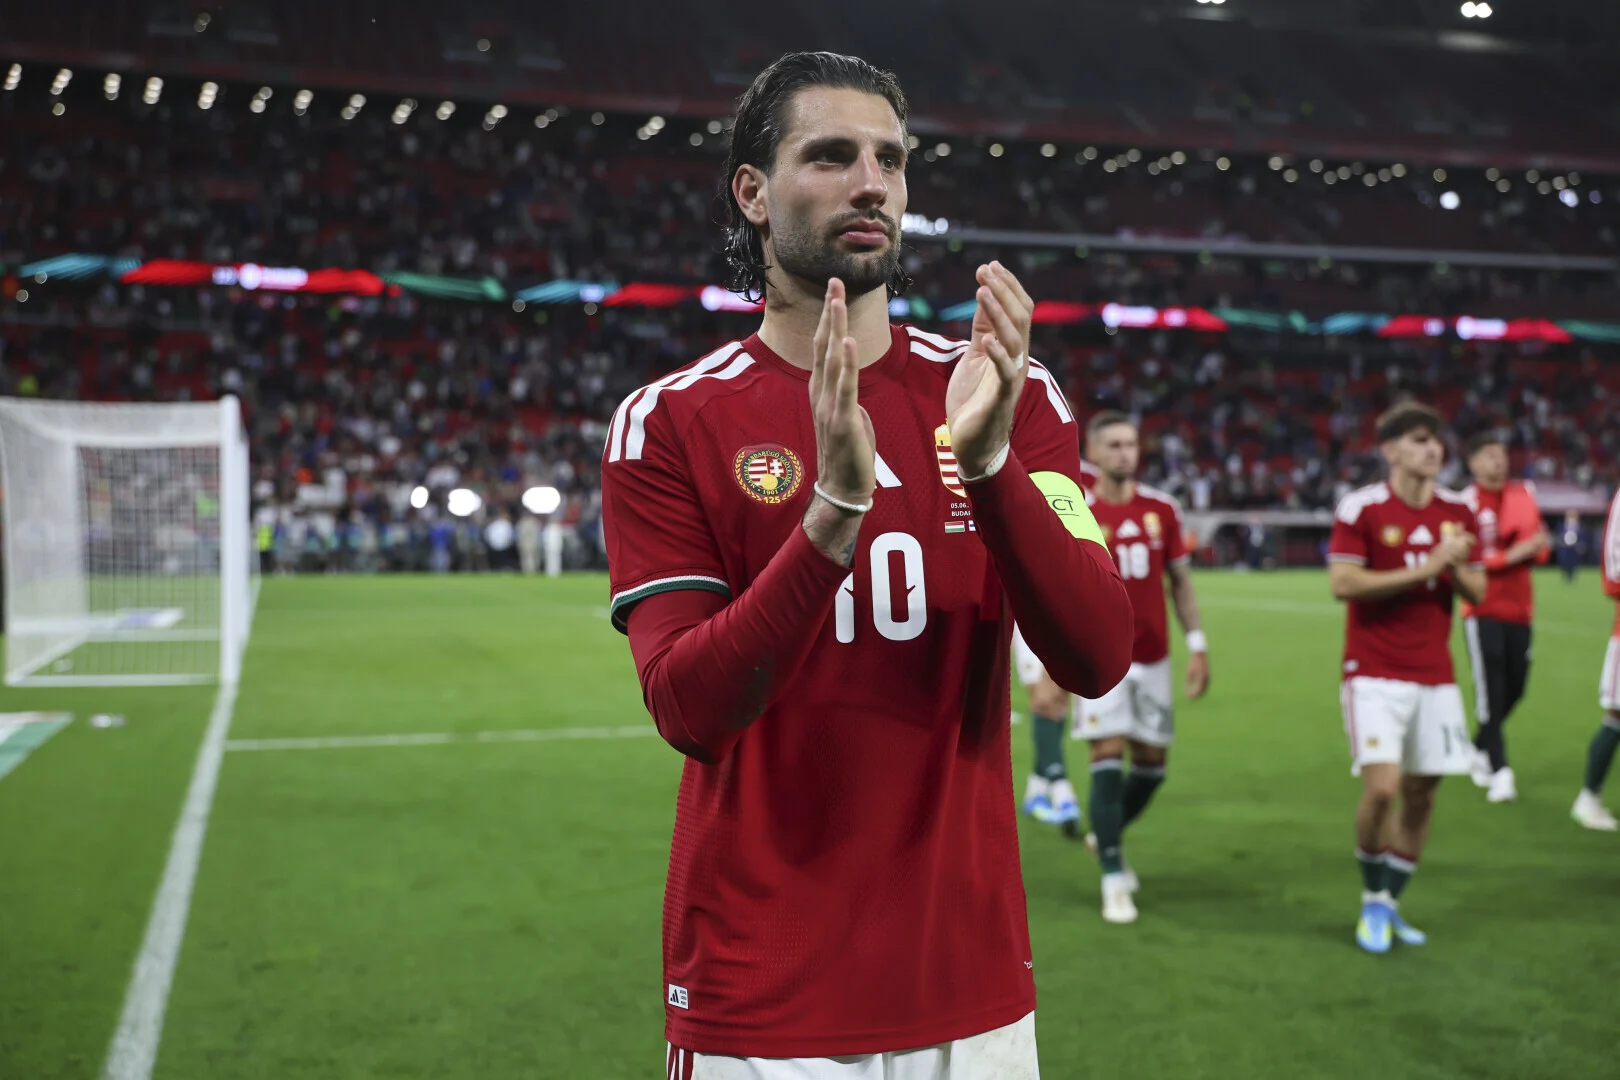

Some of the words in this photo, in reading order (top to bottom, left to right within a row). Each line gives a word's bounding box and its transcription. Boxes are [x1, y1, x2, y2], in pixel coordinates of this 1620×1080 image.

[764, 496, 781, 504] 125
[1052, 499, 1074, 511] CT
[835, 532, 927, 643] 10
